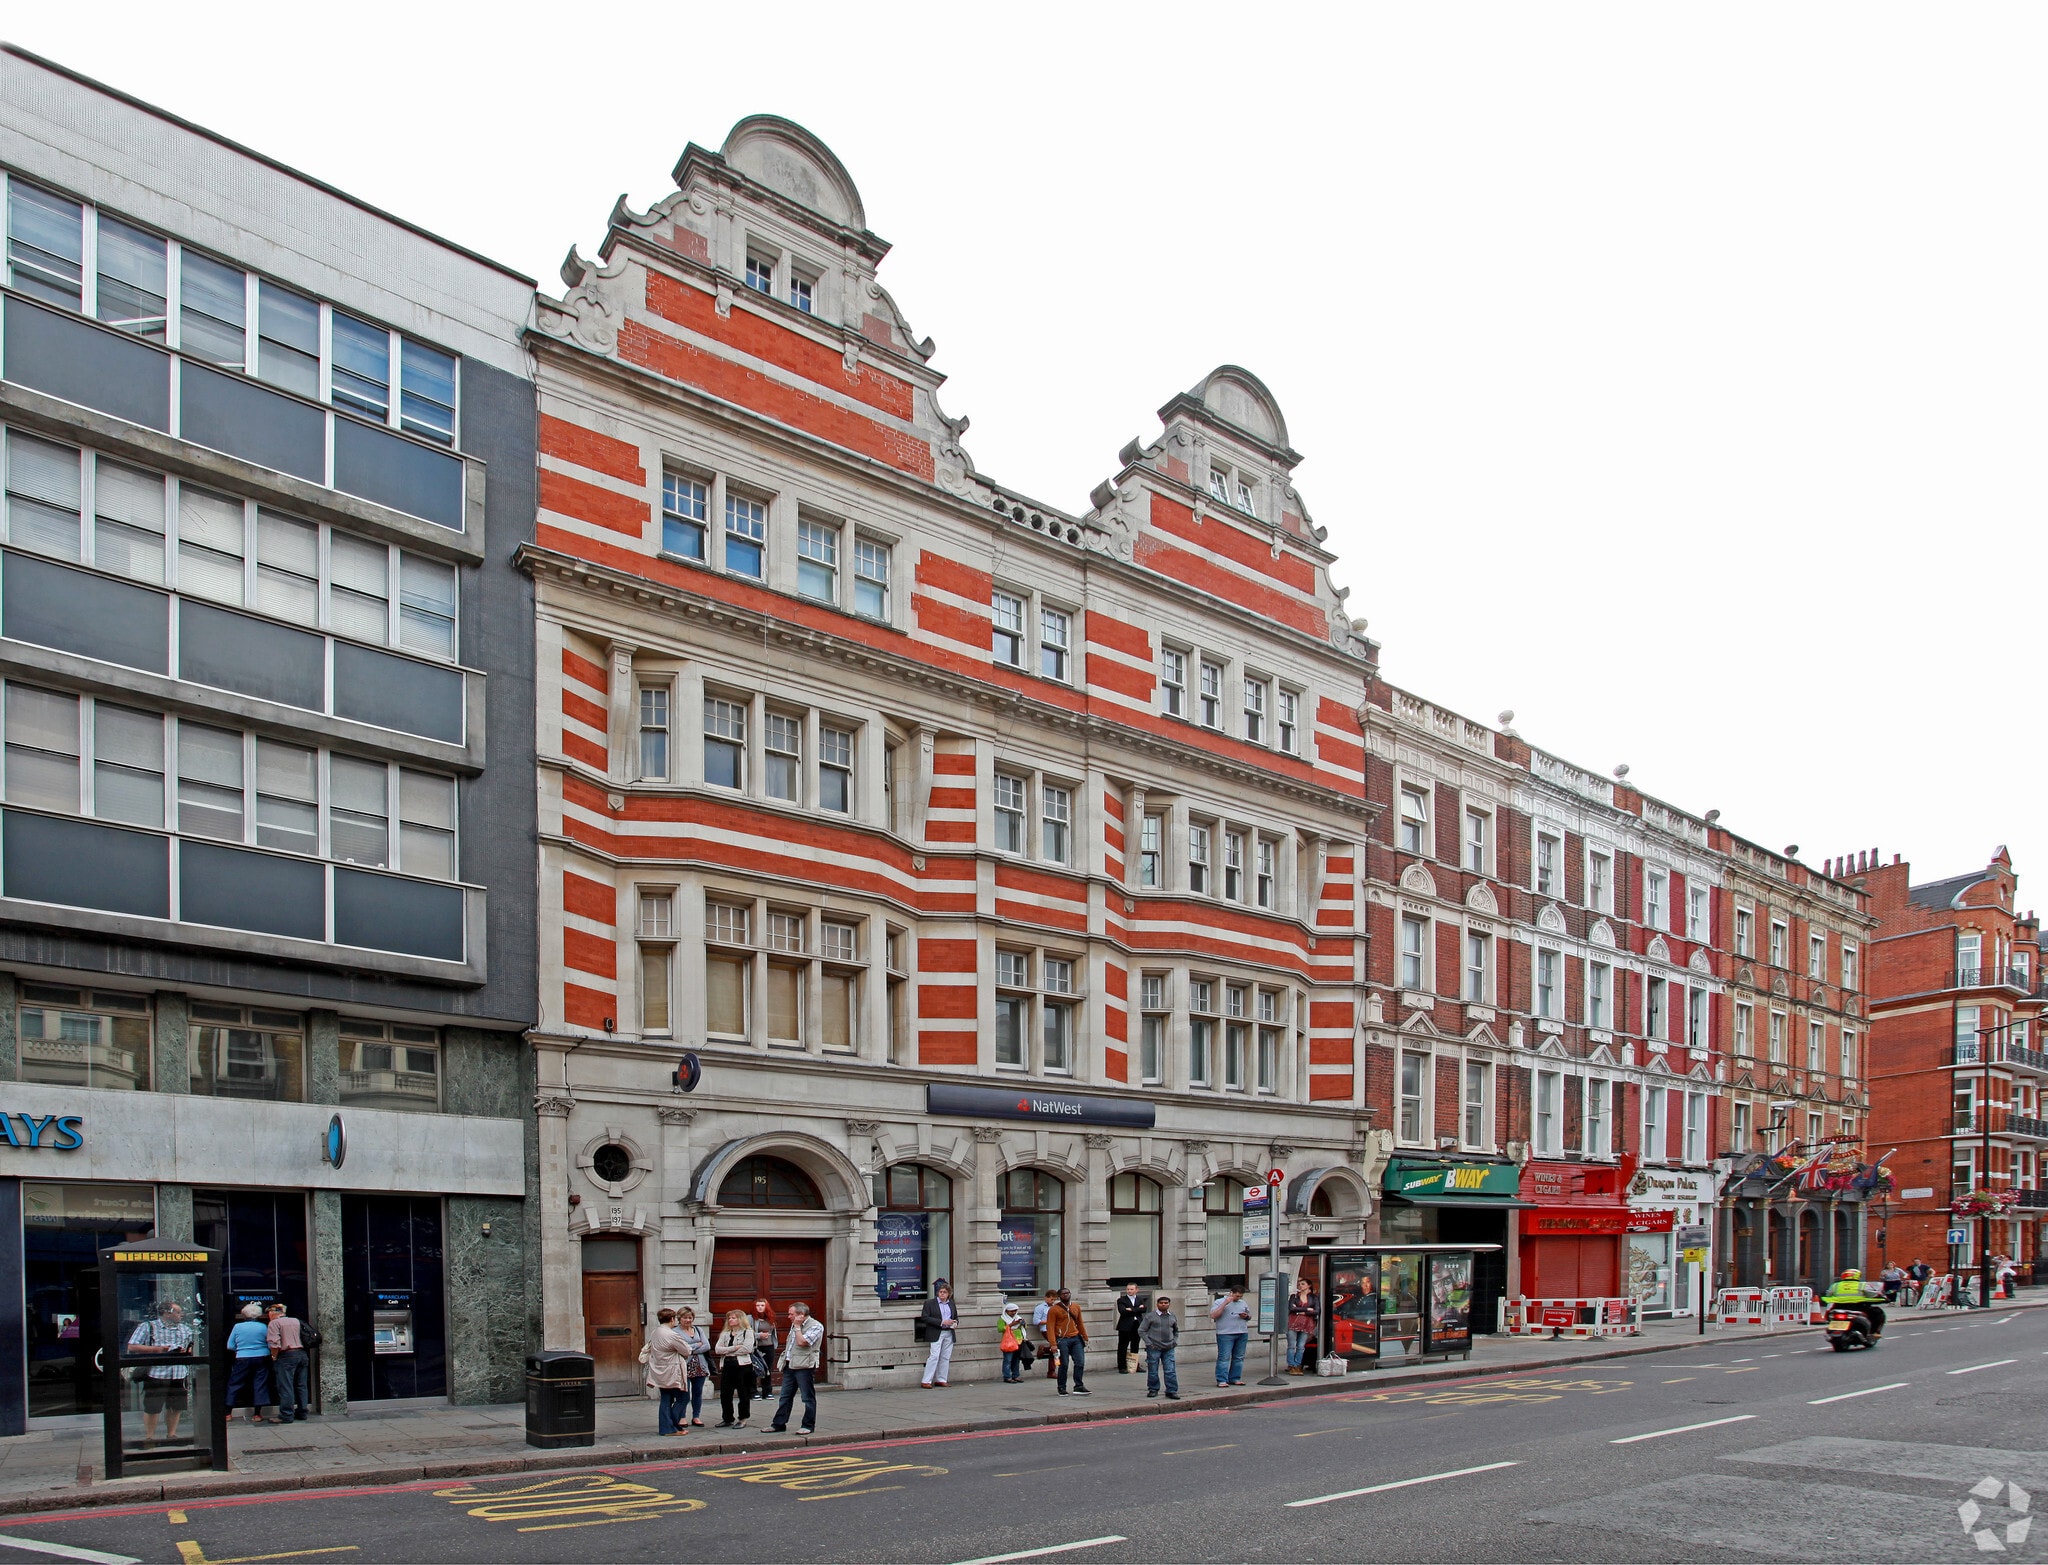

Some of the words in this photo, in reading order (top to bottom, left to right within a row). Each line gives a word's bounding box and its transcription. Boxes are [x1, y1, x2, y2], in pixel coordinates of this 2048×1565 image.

[1033, 1100, 1082, 1115] NatWest
[754, 1176, 767, 1185] 195
[1270, 1171, 1281, 1182] A
[1534, 1172, 1556, 1183] WINES
[1403, 1173, 1443, 1191] SUBWAY
[1535, 1185, 1561, 1195] CIGARS
[1309, 1223, 1323, 1232] 201
[899, 1230, 910, 1238] yes
[125, 1252, 199, 1260] TELEPHONE
[878, 1256, 914, 1264] pplications
